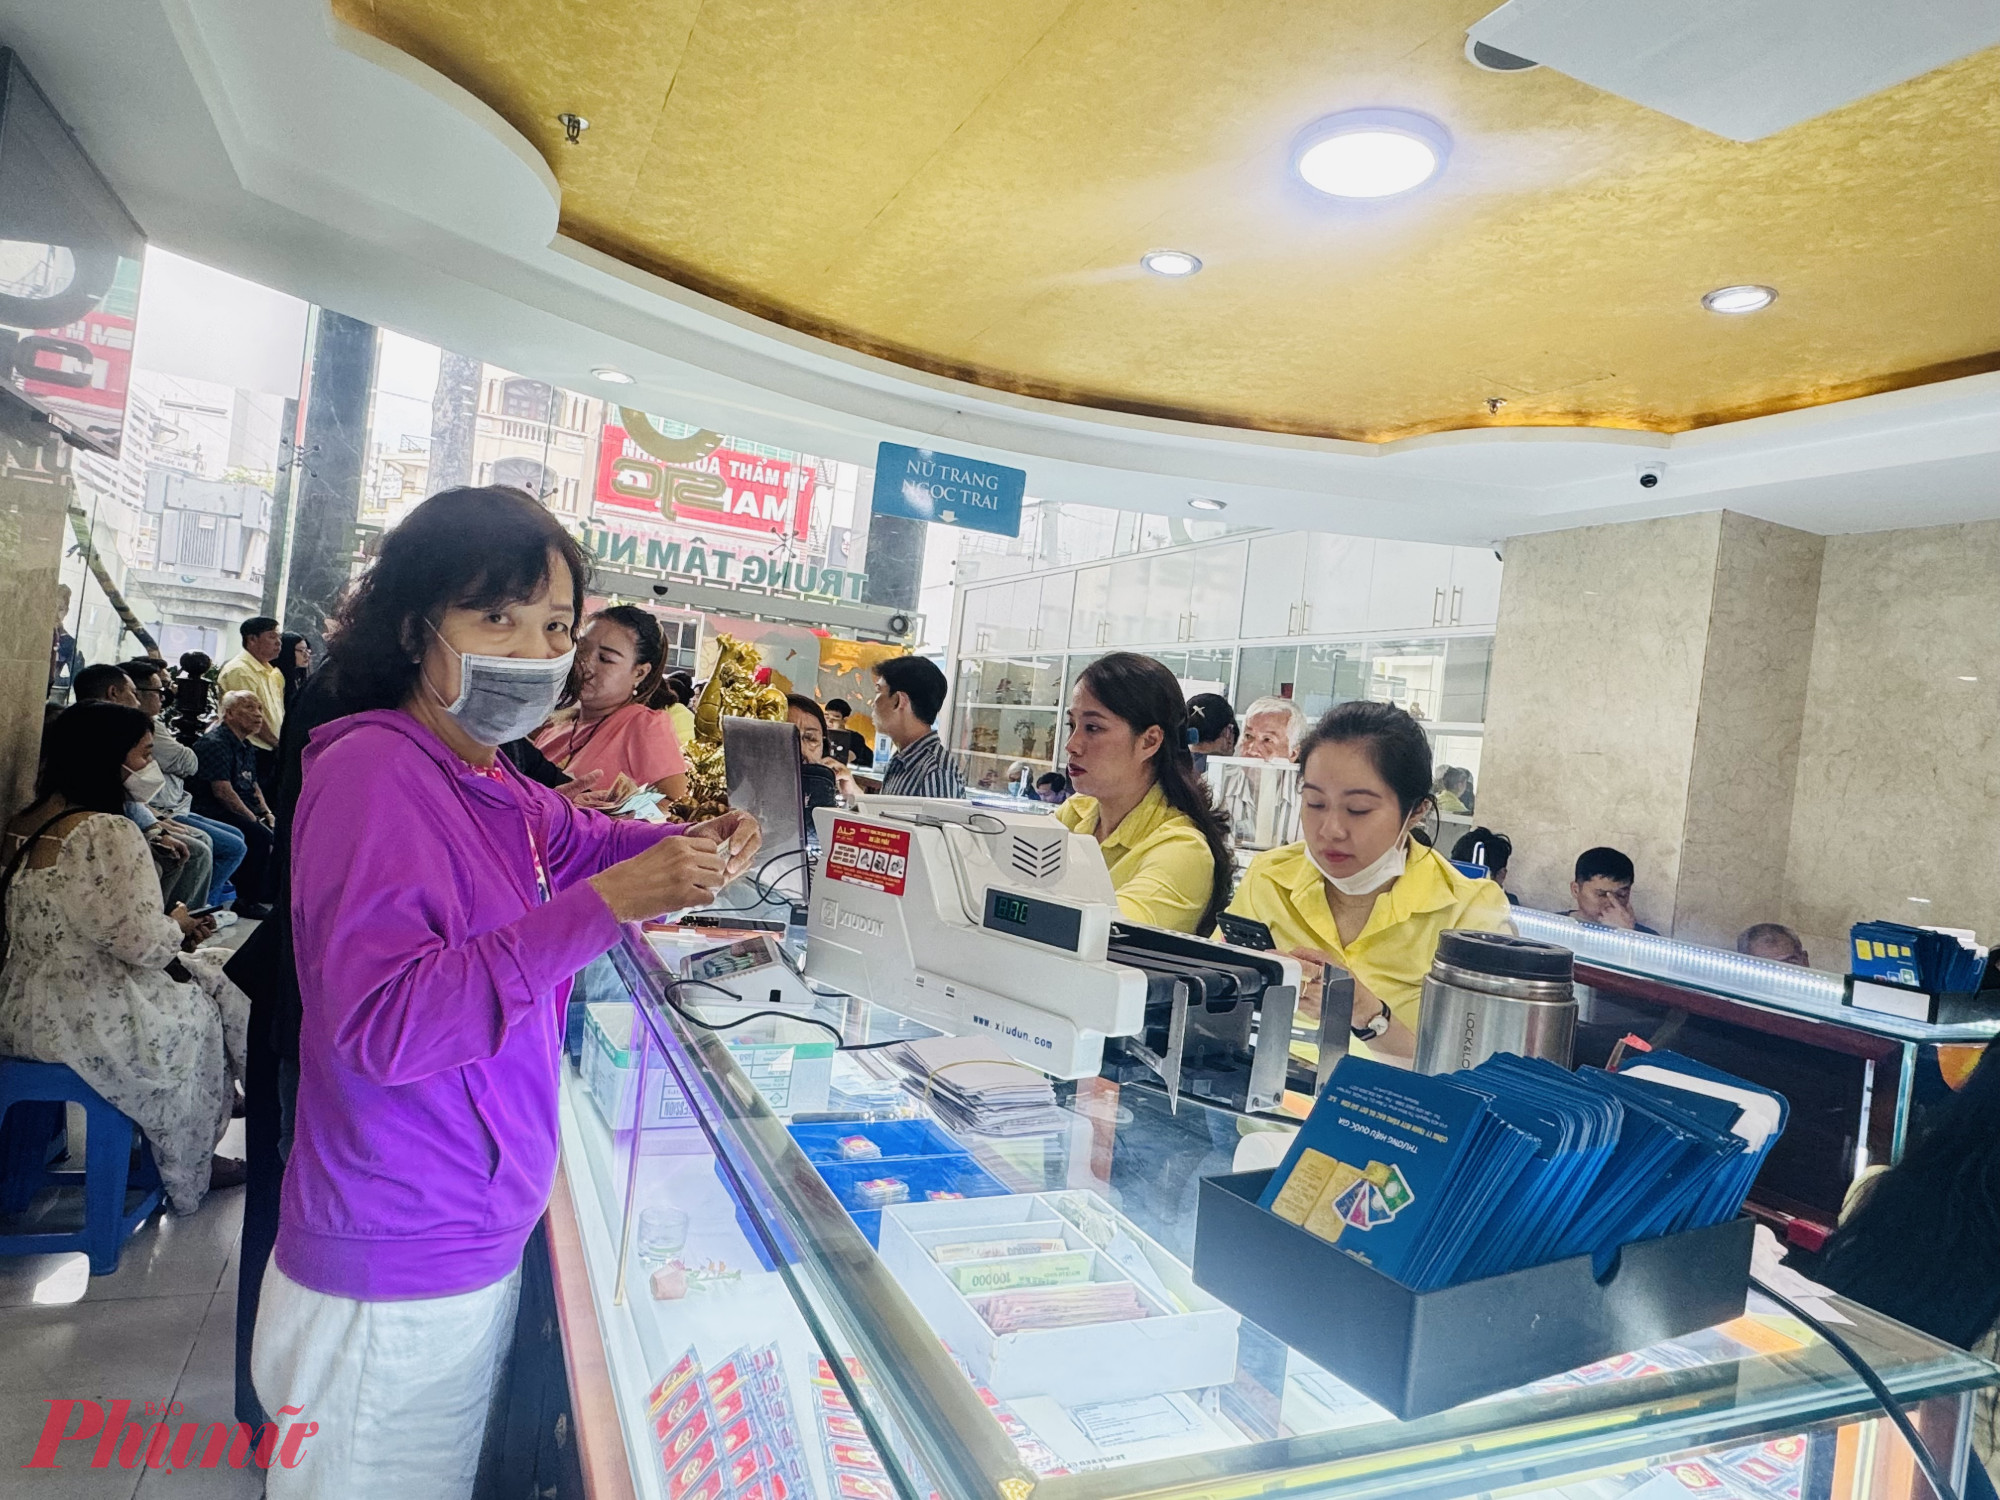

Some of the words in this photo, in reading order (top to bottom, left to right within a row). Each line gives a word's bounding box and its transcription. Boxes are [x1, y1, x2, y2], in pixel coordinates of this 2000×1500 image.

[728, 458, 780, 487] THẨM
[906, 458, 937, 478] NỮ
[937, 464, 999, 491] TRANG
[959, 489, 999, 512] TRAI
[1350, 1121, 1370, 1135] QUỐC
[1369, 1127, 1388, 1141] HIỆU
[1386, 1135, 1418, 1154] THƯƠNG
